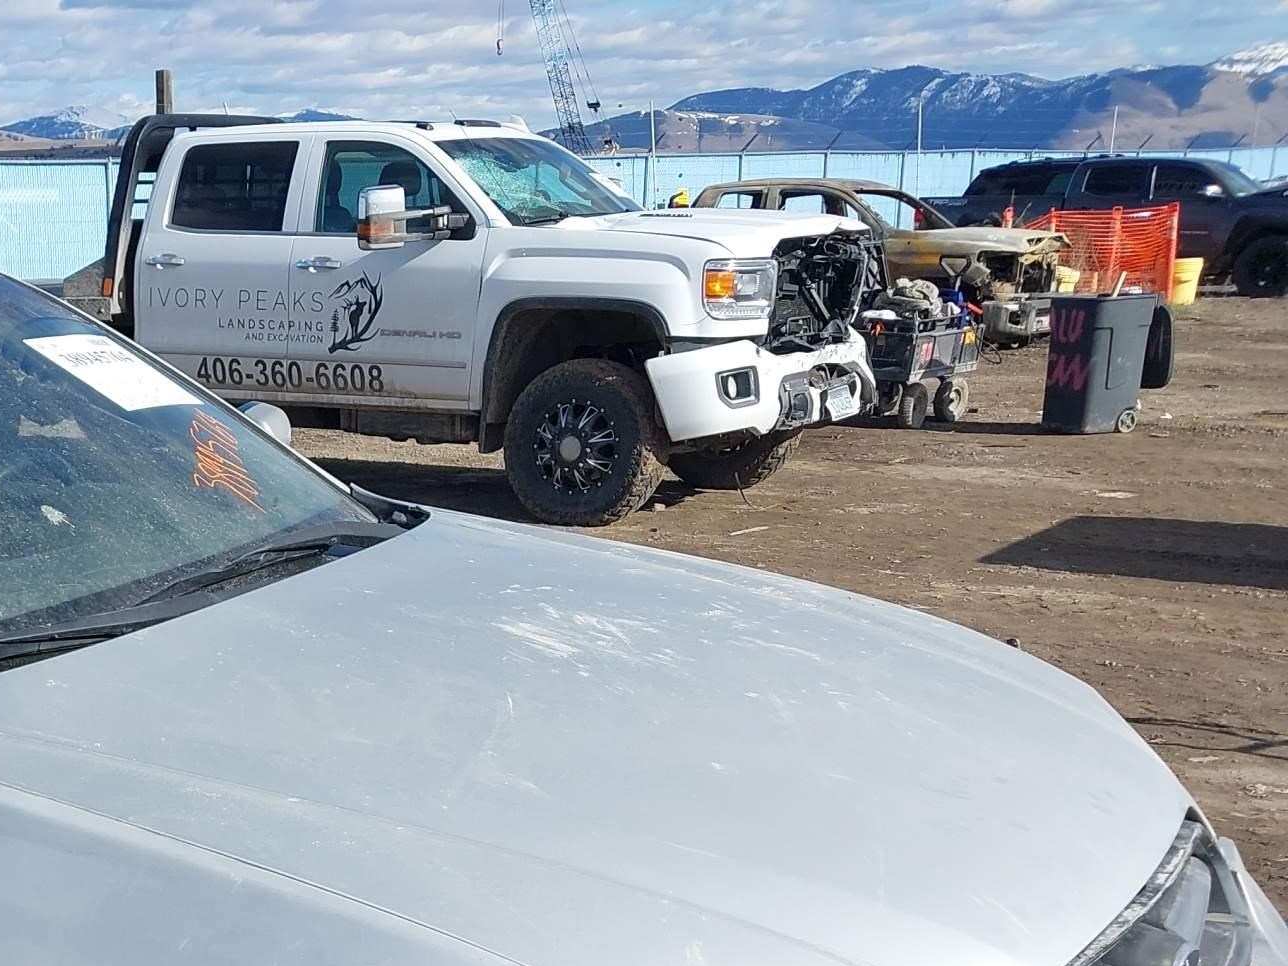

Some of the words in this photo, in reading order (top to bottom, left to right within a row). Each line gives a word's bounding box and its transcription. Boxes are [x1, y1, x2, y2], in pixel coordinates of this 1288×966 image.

[148, 287, 225, 310] IVORY
[237, 289, 325, 313] PEAKS
[217, 317, 325, 333] LANDSCAPING
[244, 332, 264, 342] AND
[266, 332, 325, 345] EXCAVATION
[196, 356, 385, 393] 406-360-6608
